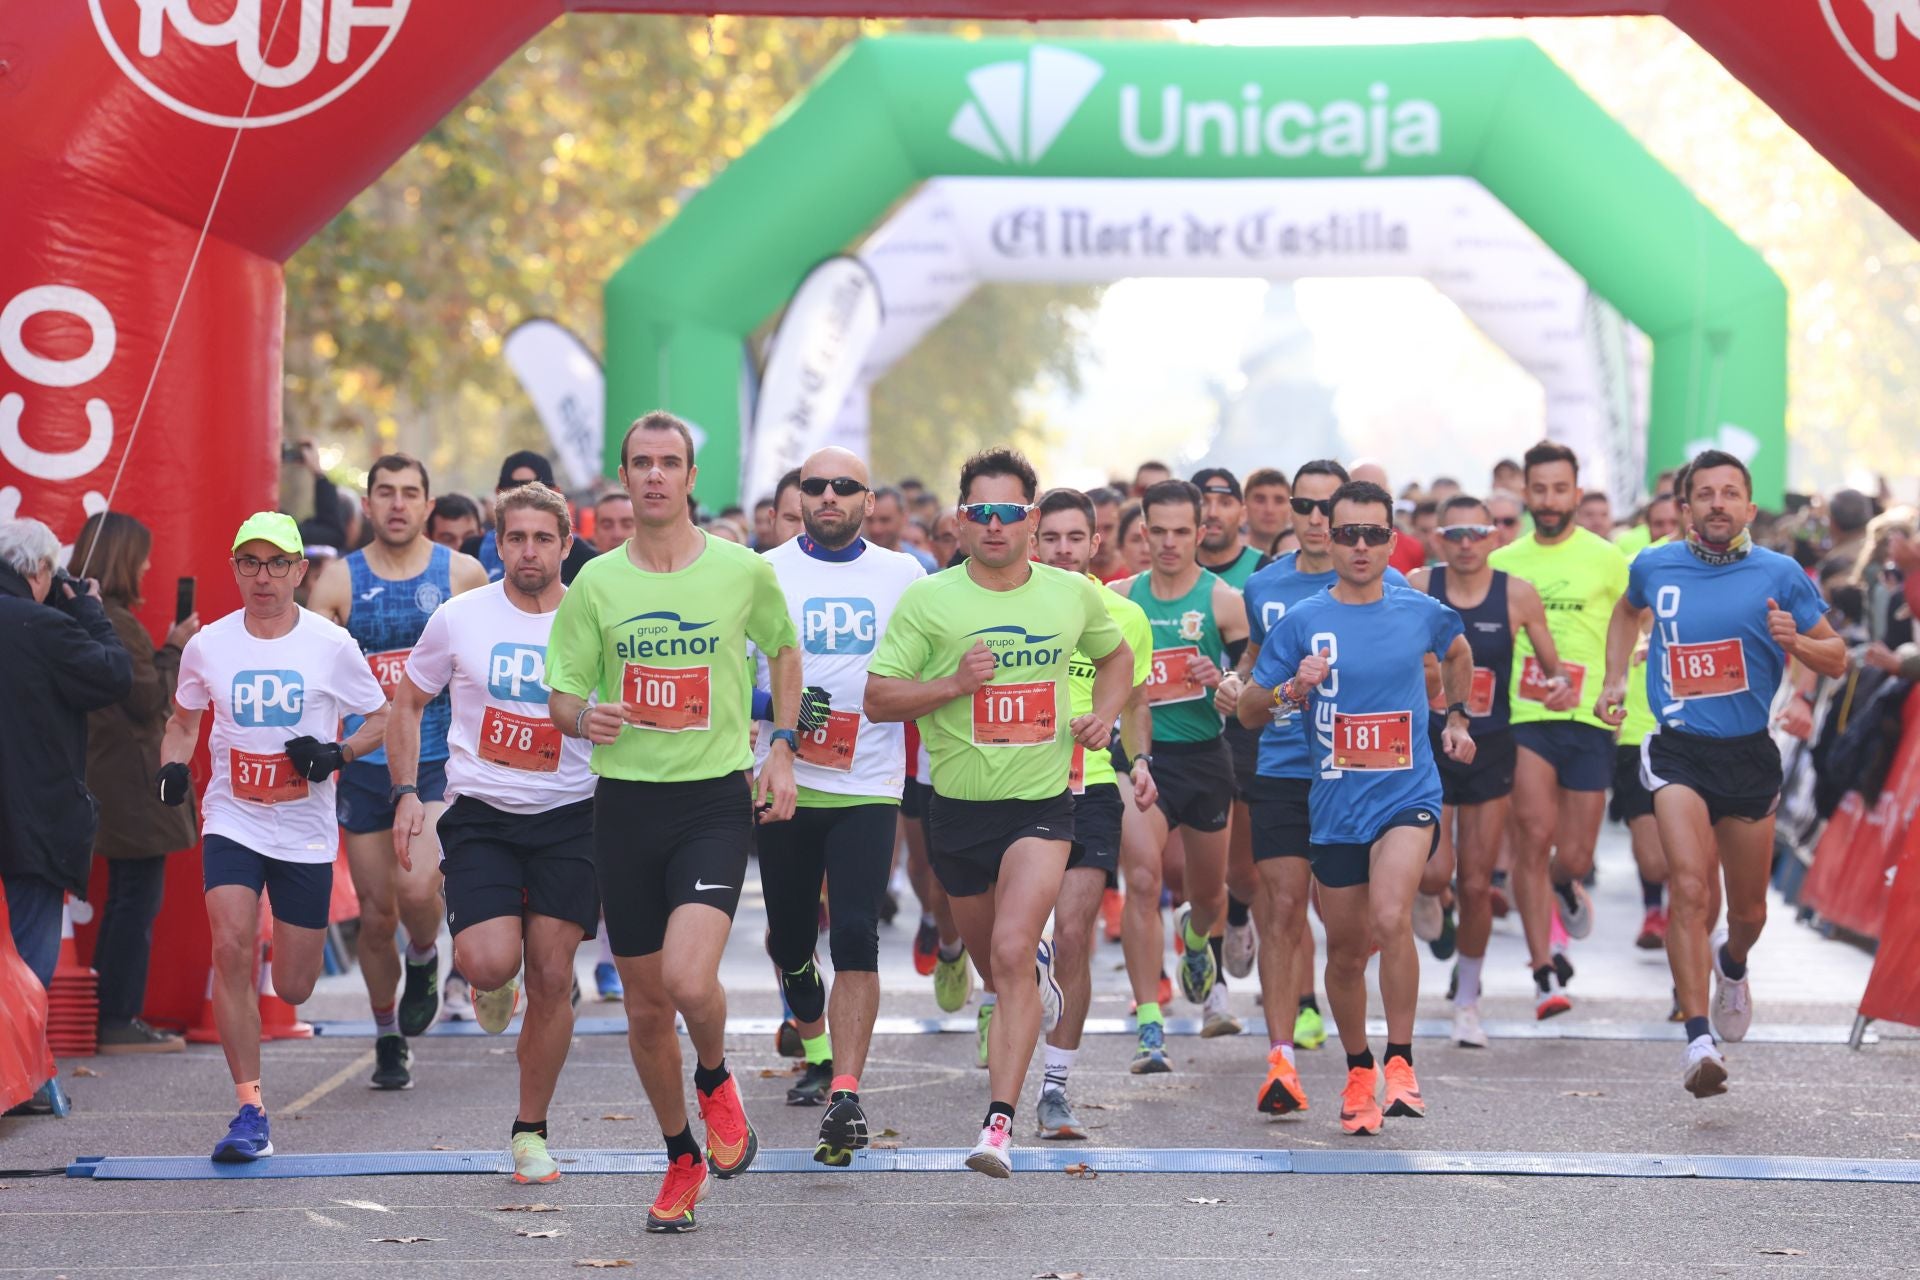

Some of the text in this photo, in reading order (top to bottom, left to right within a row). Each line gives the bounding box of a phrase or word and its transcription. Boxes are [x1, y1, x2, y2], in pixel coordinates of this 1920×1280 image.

[1118, 81, 1441, 172] Unicaja
[991, 207, 1410, 260] El Norte de Castilla
[637, 625, 668, 637] grupo
[805, 601, 873, 650] PPG
[616, 634, 720, 659] elecnor
[986, 637, 1015, 649] grupo
[377, 660, 407, 685] 26
[1677, 653, 1716, 679] 183
[234, 674, 302, 723] PPG
[634, 677, 676, 708] 100
[985, 695, 1025, 723] 101
[490, 719, 533, 751] 378
[1344, 725, 1380, 750] 181
[239, 761, 277, 787] 377
